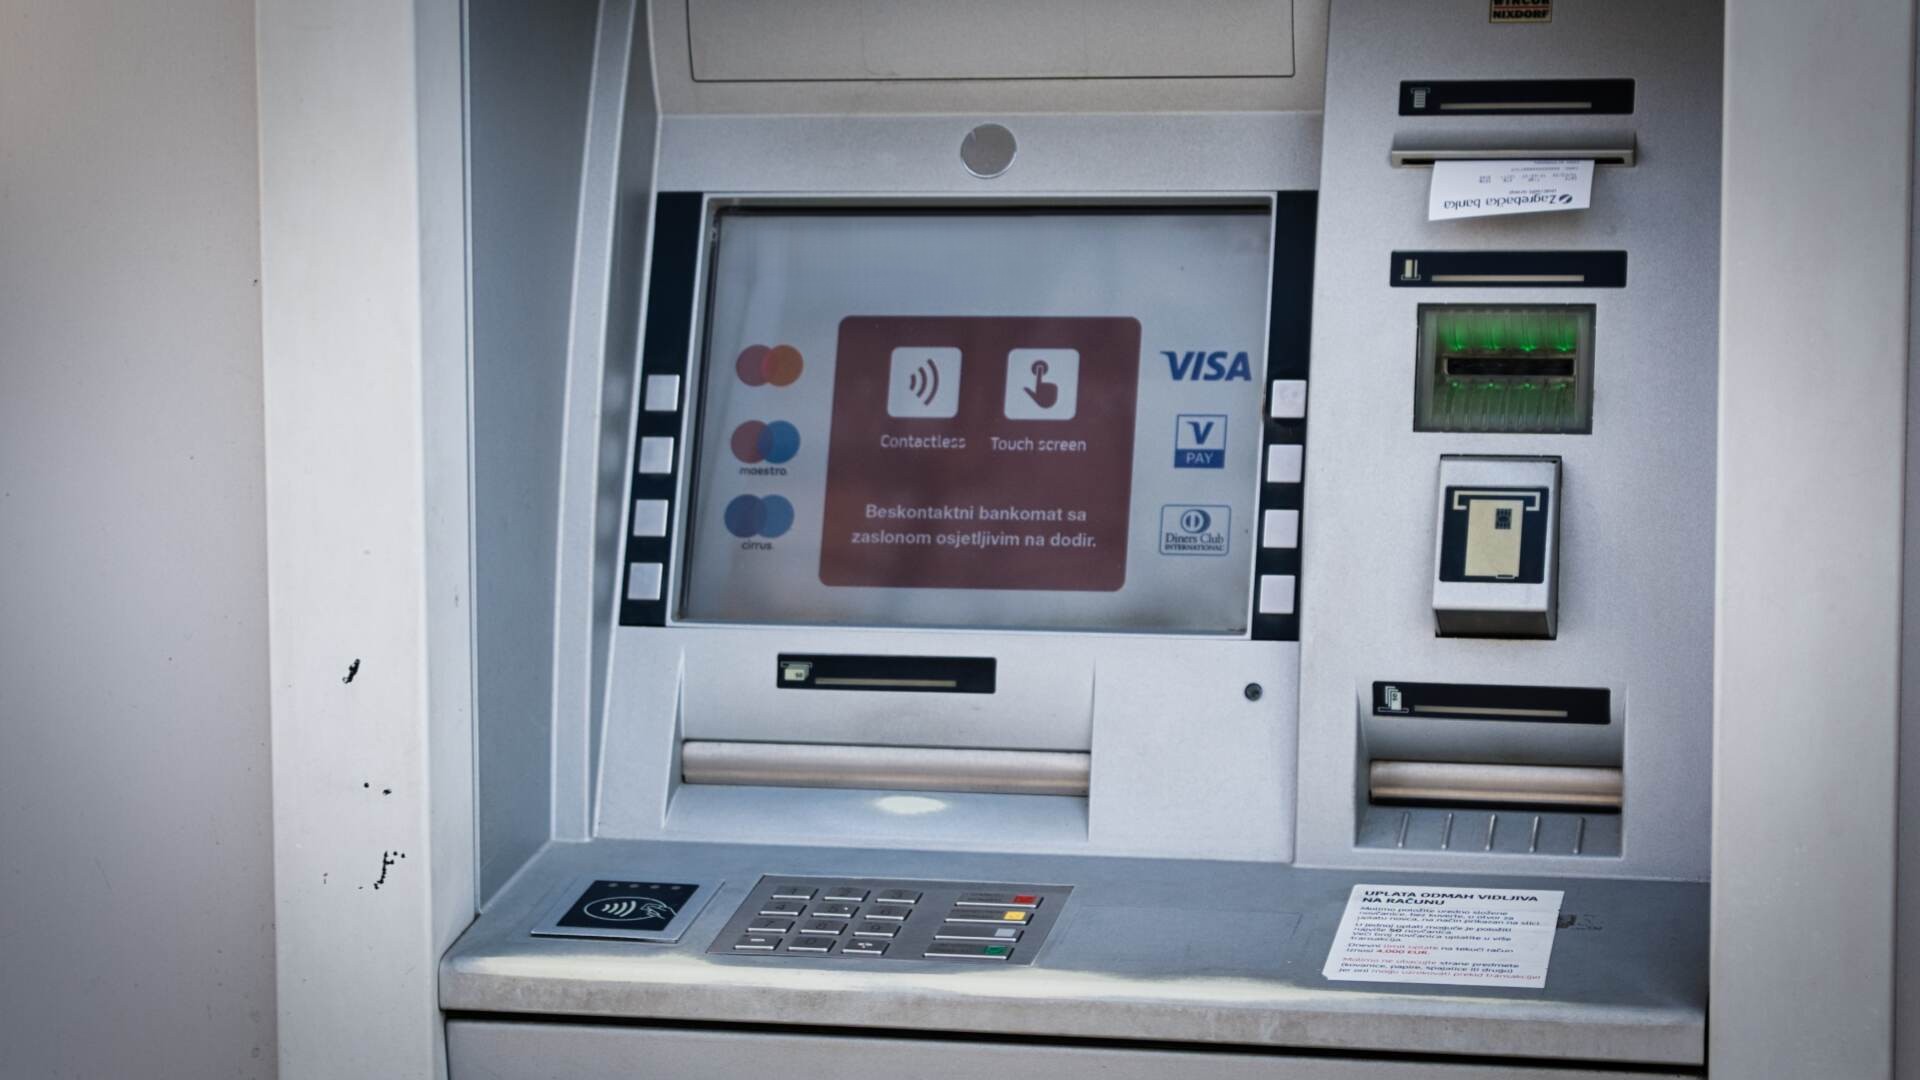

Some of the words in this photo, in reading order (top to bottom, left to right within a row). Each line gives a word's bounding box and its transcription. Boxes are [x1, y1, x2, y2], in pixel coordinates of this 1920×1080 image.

[1444, 198, 1481, 211] banka
[1160, 351, 1252, 381] VISA
[1186, 421, 1214, 445] V
[880, 434, 967, 449] Contactless
[991, 436, 1034, 451] Touch
[1038, 438, 1087, 451] screen
[1186, 452, 1213, 464] PAY
[739, 466, 787, 477] maestro
[865, 504, 974, 520] Beskontaktni
[979, 505, 1062, 521] bankomat
[1067, 510, 1087, 521] sa
[741, 540, 772, 550] cirrus
[851, 530, 931, 545] zaslonom
[936, 530, 1020, 549] osjetljivim
[1025, 534, 1045, 547] na
[1050, 532, 1097, 548] dodir.
[1165, 533, 1198, 544] Diners
[1200, 533, 1224, 545] Club
[1386, 896, 1445, 905] RAČUNU
